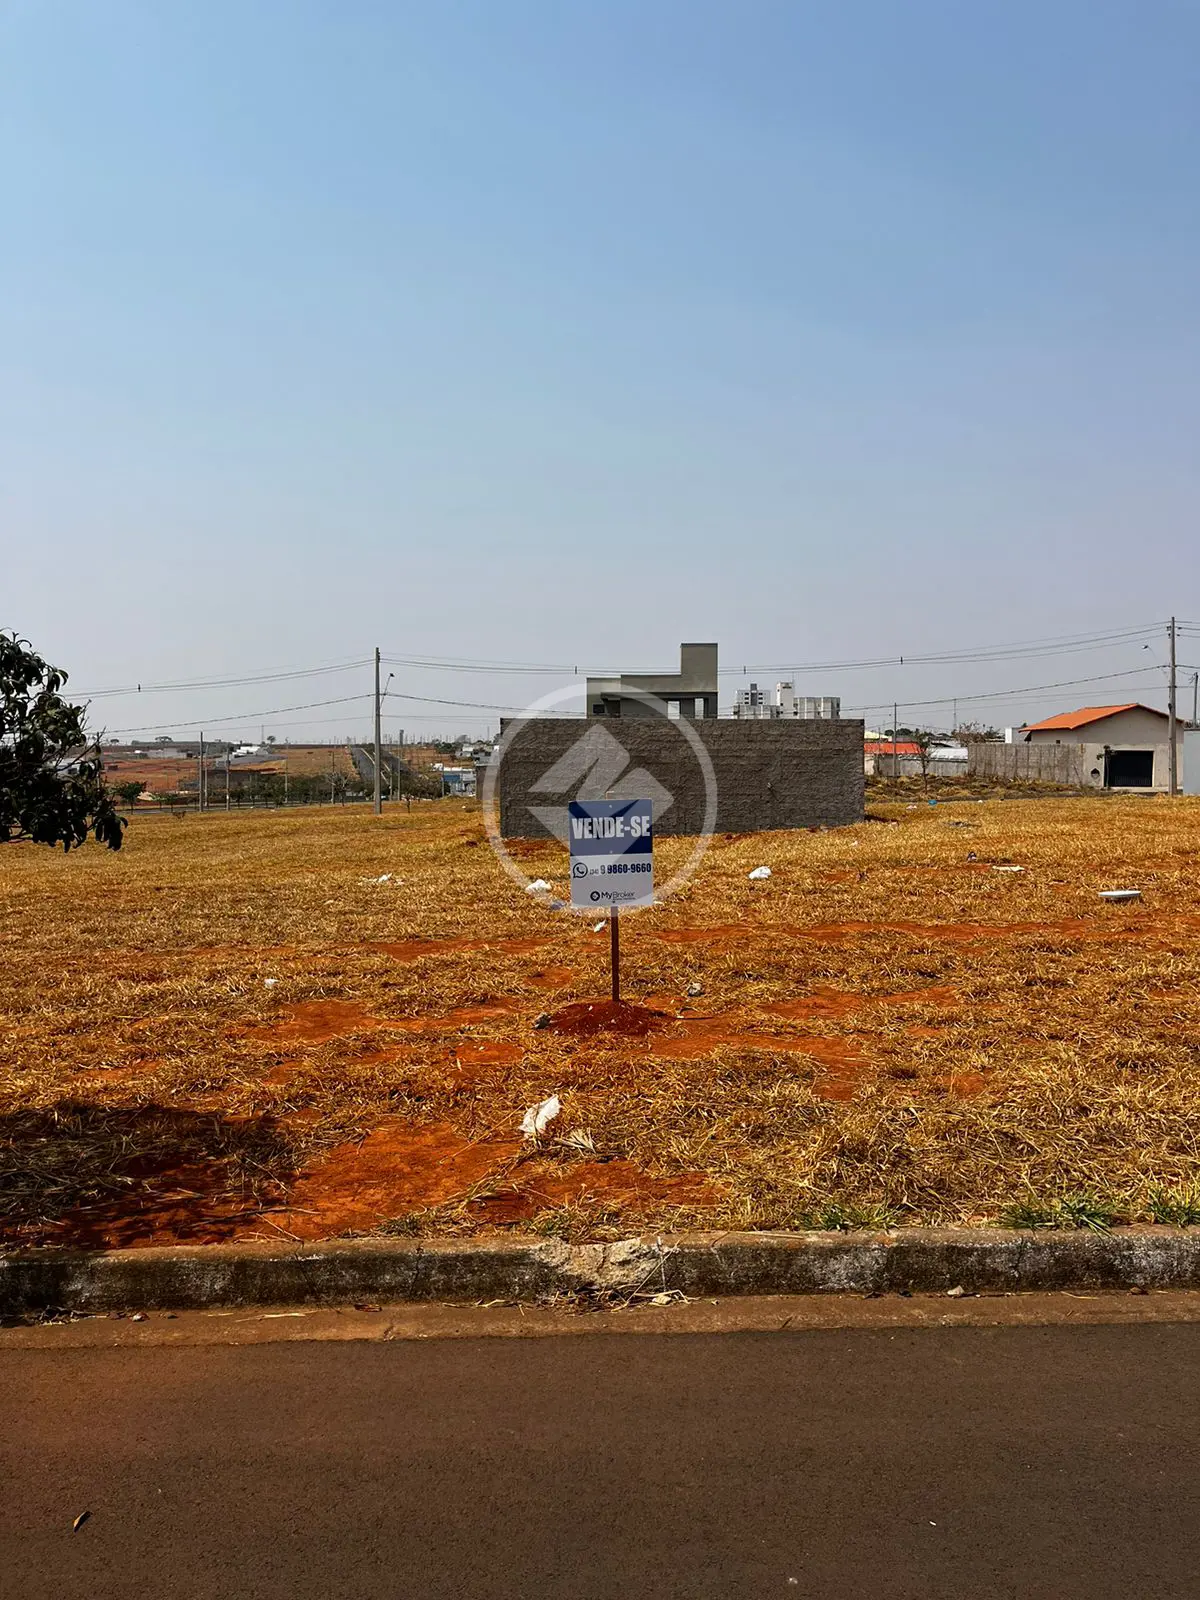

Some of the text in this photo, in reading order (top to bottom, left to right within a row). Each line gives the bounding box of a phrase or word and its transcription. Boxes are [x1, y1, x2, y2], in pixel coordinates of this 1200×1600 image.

[571, 816, 651, 839] VENDE-SE
[600, 865, 606, 875] 9
[607, 863, 652, 874] 9860-9660
[601, 891, 635, 900] MyBroker
